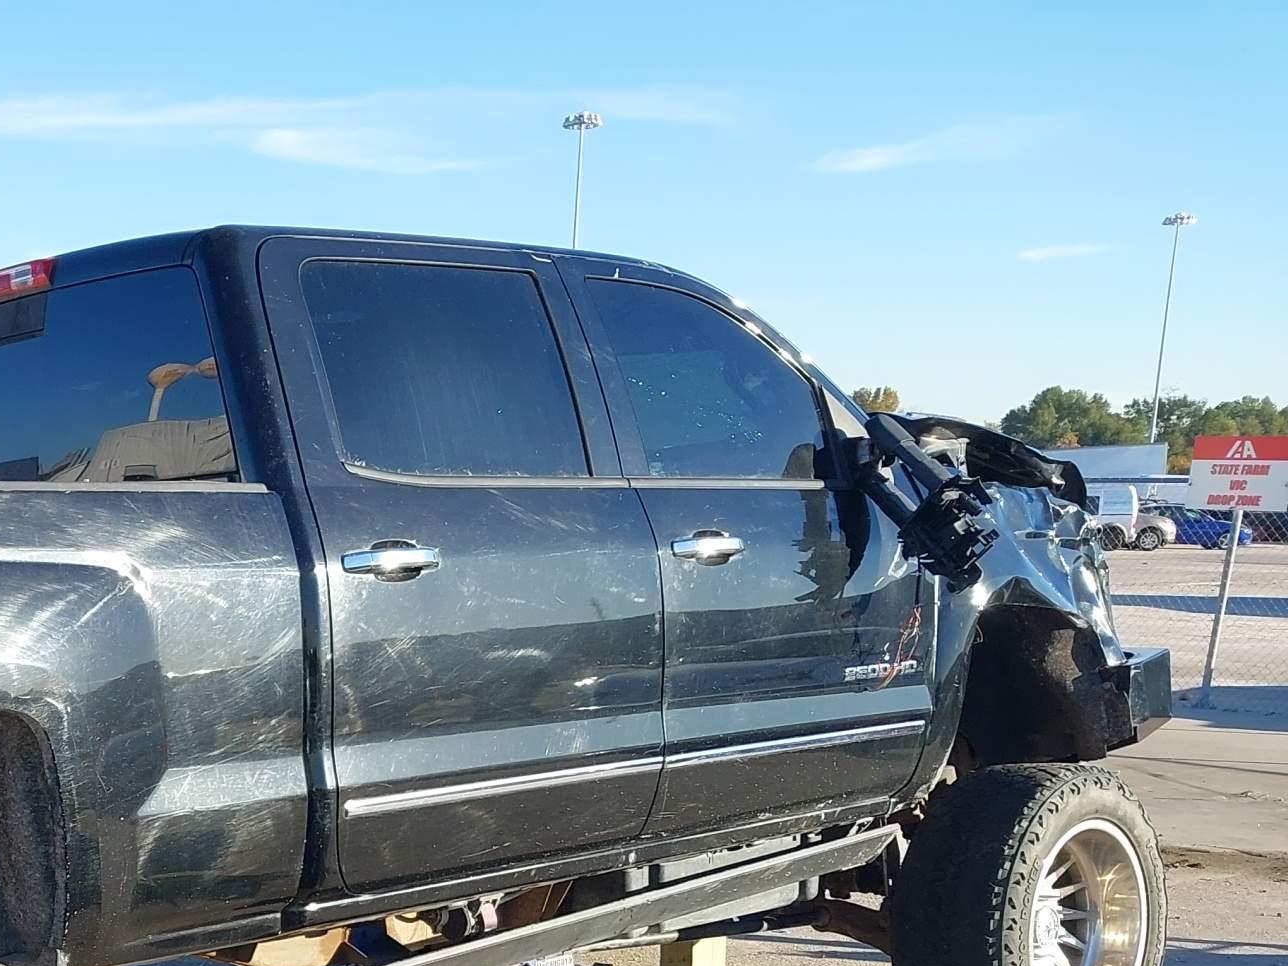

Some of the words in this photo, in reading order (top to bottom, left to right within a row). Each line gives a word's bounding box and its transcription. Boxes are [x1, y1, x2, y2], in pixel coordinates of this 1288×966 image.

[1210, 464, 1240, 476] STATE
[1241, 464, 1271, 476] FARM
[1229, 479, 1248, 491] VIC
[1207, 494, 1235, 506] DROP
[1236, 495, 1263, 506] ZONE
